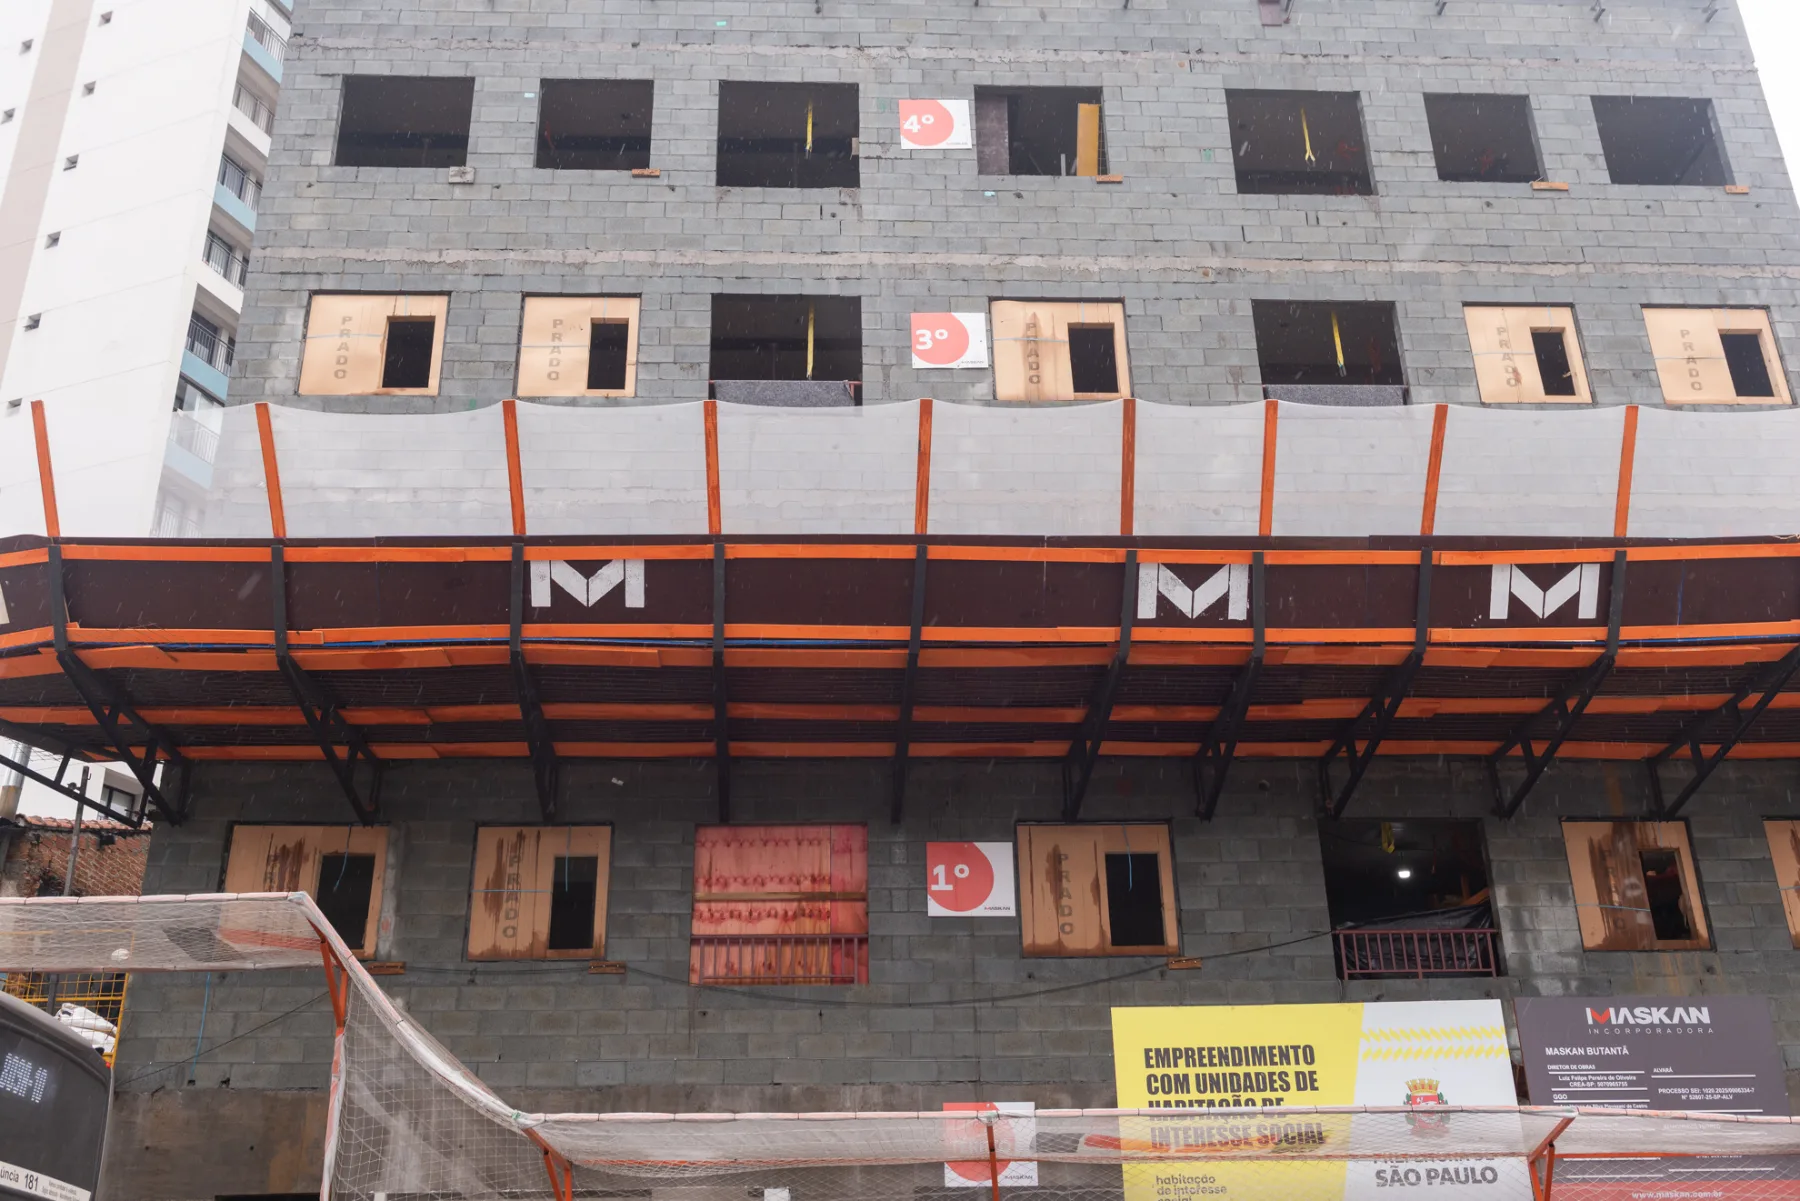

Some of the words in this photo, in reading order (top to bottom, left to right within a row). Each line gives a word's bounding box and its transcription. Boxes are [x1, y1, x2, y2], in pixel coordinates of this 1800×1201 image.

[334, 315, 353, 380] PRADO
[546, 318, 564, 381] PRADO
[1026, 322, 1041, 385] PRADO
[1496, 327, 1518, 388] PRADO
[1680, 329, 1702, 391] PRADO
[1058, 854, 1075, 935] PRADO
[1585, 1006, 1711, 1025] MASKAN
[1588, 1027, 1714, 1035] INCORPORADORA
[1144, 1044, 1315, 1069] EMPREENDIMENTO
[1545, 1047, 1585, 1056] MASKAN
[1587, 1045, 1630, 1056] BUTANTÃ
[1146, 1073, 1190, 1096] COM
[1195, 1071, 1290, 1094] UNIDADES
[1295, 1070, 1319, 1092] DE
[1150, 1125, 1253, 1149] INTERESSE
[1256, 1122, 1325, 1146] SOCIAL
[25, 1173, 39, 1191] 181
[1156, 1174, 1216, 1186] habitação
[1375, 1165, 1421, 1187] SÃO
[1425, 1166, 1498, 1186] PAULO
[1157, 1184, 1170, 1196] de
[1174, 1183, 1227, 1195] interesse
